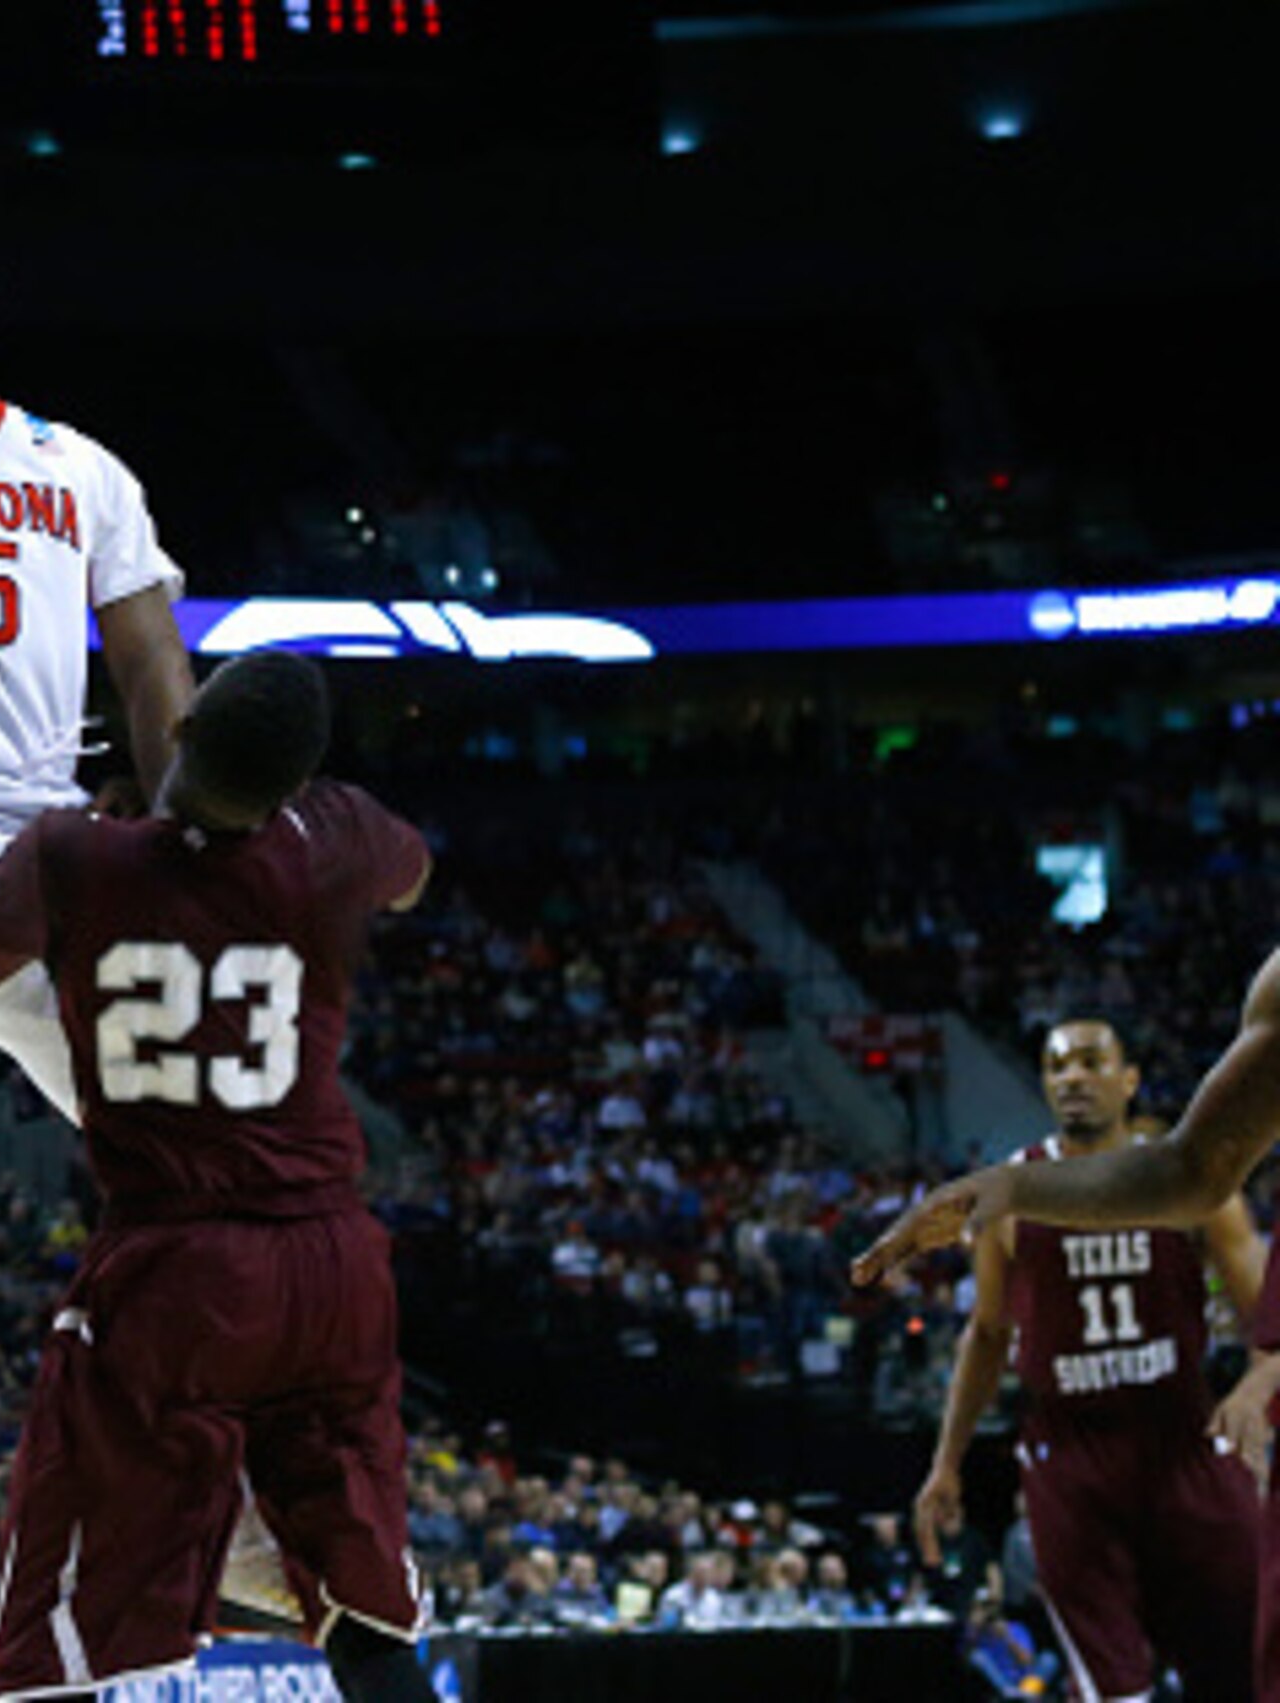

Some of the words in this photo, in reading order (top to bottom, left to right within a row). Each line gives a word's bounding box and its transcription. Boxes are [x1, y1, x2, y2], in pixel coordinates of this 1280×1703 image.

[96, 941, 304, 1109] 23
[1062, 1230, 1151, 1278] TEXAS
[1078, 1283, 1143, 1344] 11
